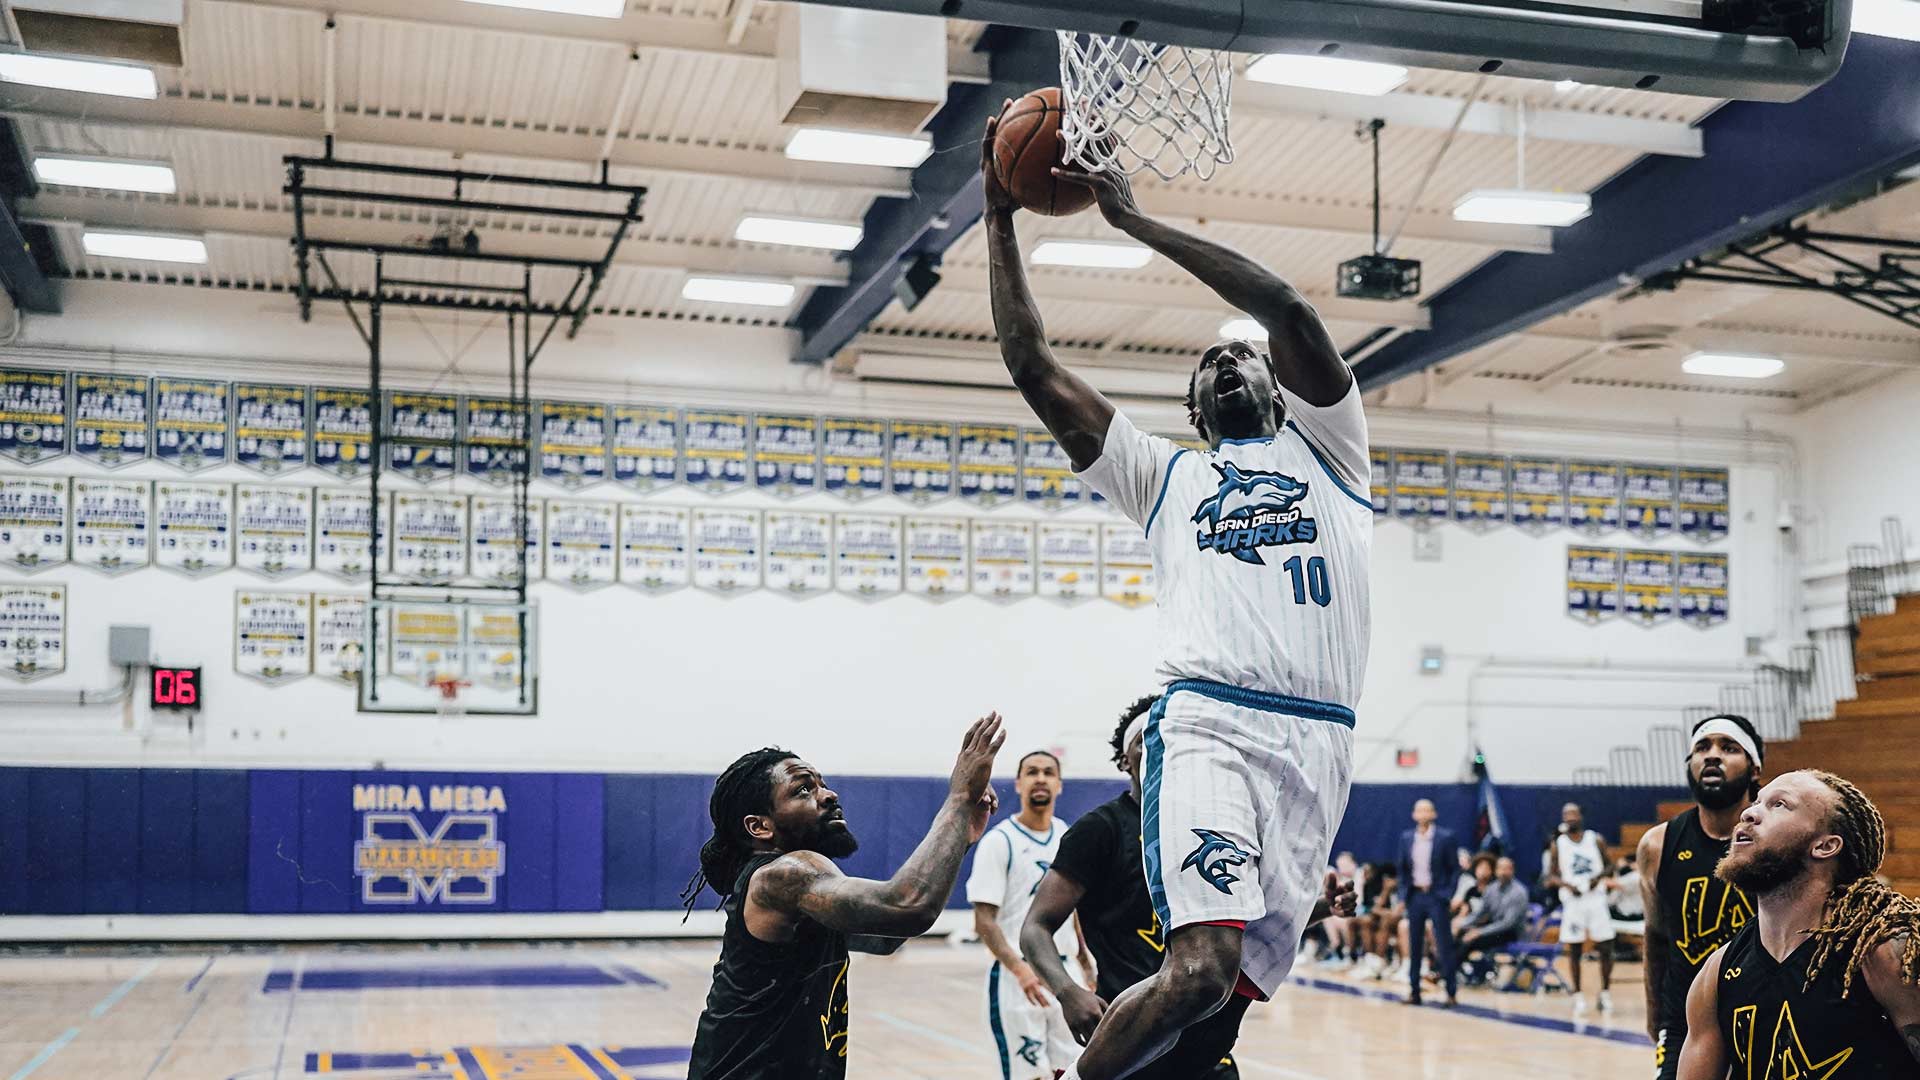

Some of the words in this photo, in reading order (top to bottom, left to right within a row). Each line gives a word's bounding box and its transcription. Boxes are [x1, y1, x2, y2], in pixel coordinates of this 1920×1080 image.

[1198, 520, 1316, 550] SHARKS
[1215, 519, 1249, 533] SAN
[1251, 510, 1300, 527] DIEGO
[1283, 555, 1332, 607] 10
[154, 670, 196, 705] 06
[353, 784, 424, 812] MIRA
[429, 785, 507, 813] MESA
